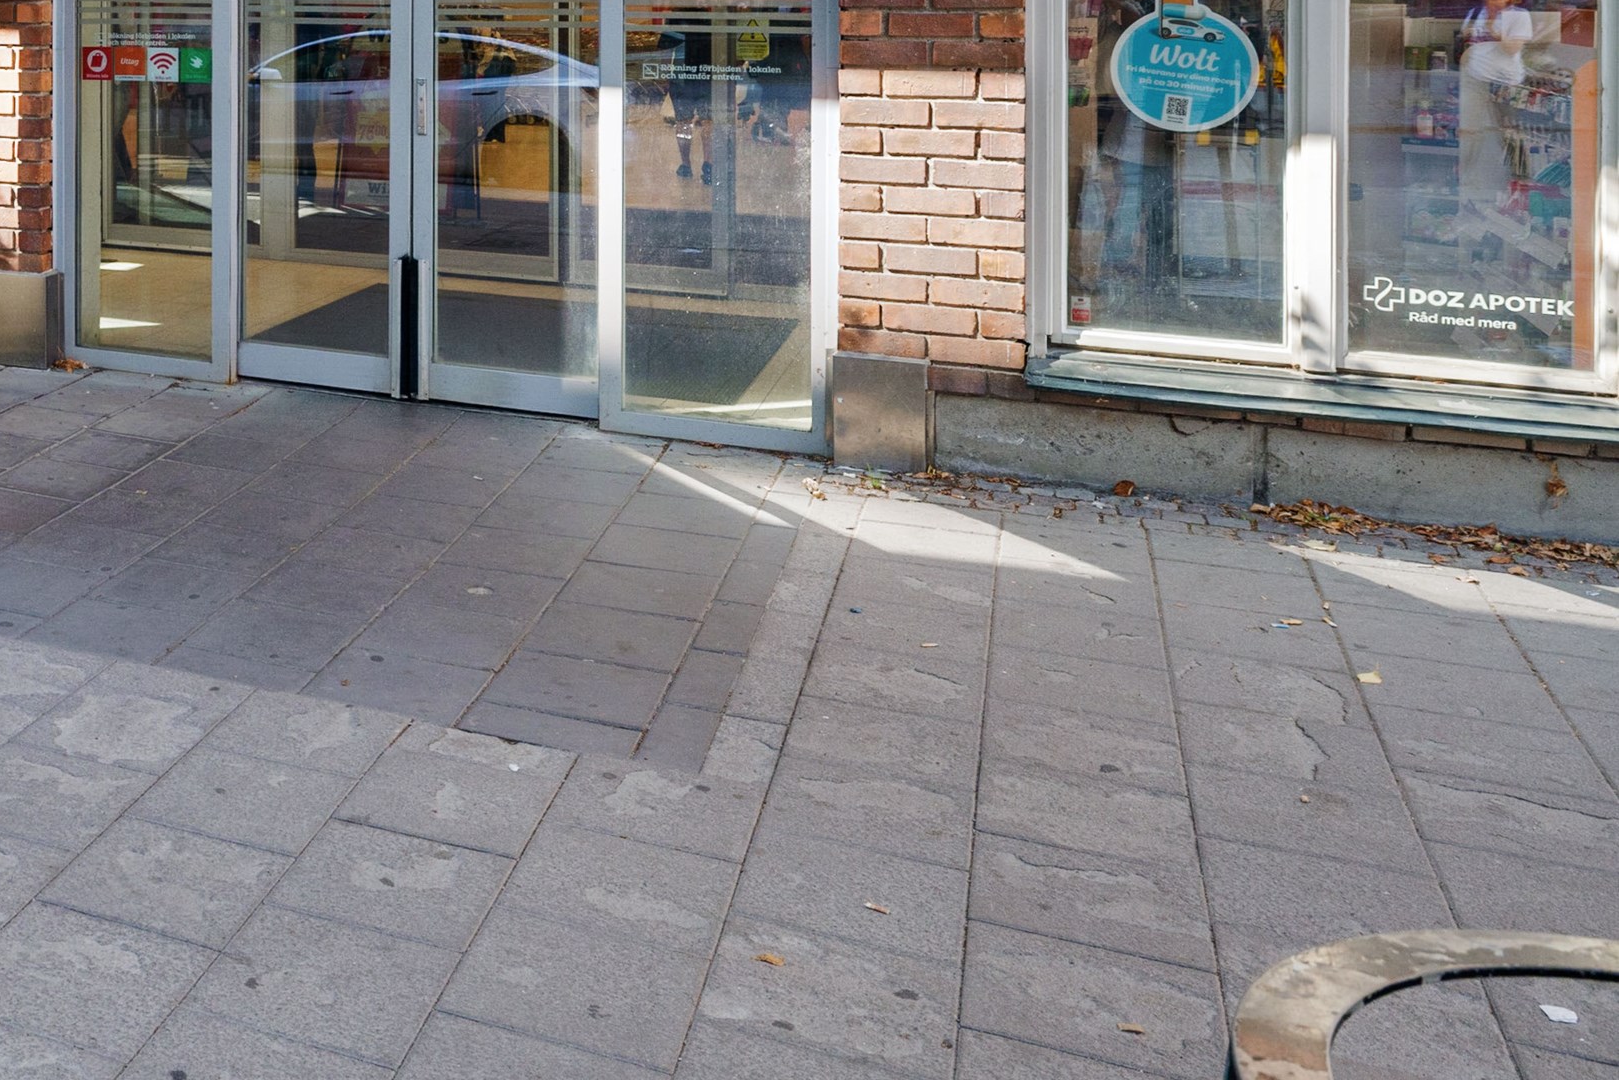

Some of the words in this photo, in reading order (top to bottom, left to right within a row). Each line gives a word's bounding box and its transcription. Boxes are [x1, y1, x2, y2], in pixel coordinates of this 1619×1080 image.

[1150, 43, 1221, 71] Wolt
[660, 64, 697, 73] Rökning
[699, 64, 742, 74] förbjuden
[749, 65, 782, 74] lokalen
[660, 72, 679, 80] och
[681, 72, 711, 80] utanför
[1408, 288, 1465, 308] DOZ
[1468, 293, 1575, 317] APOTEK
[1409, 311, 1438, 324] Råd
[1441, 314, 1475, 327] med
[1478, 317, 1517, 331] mera
